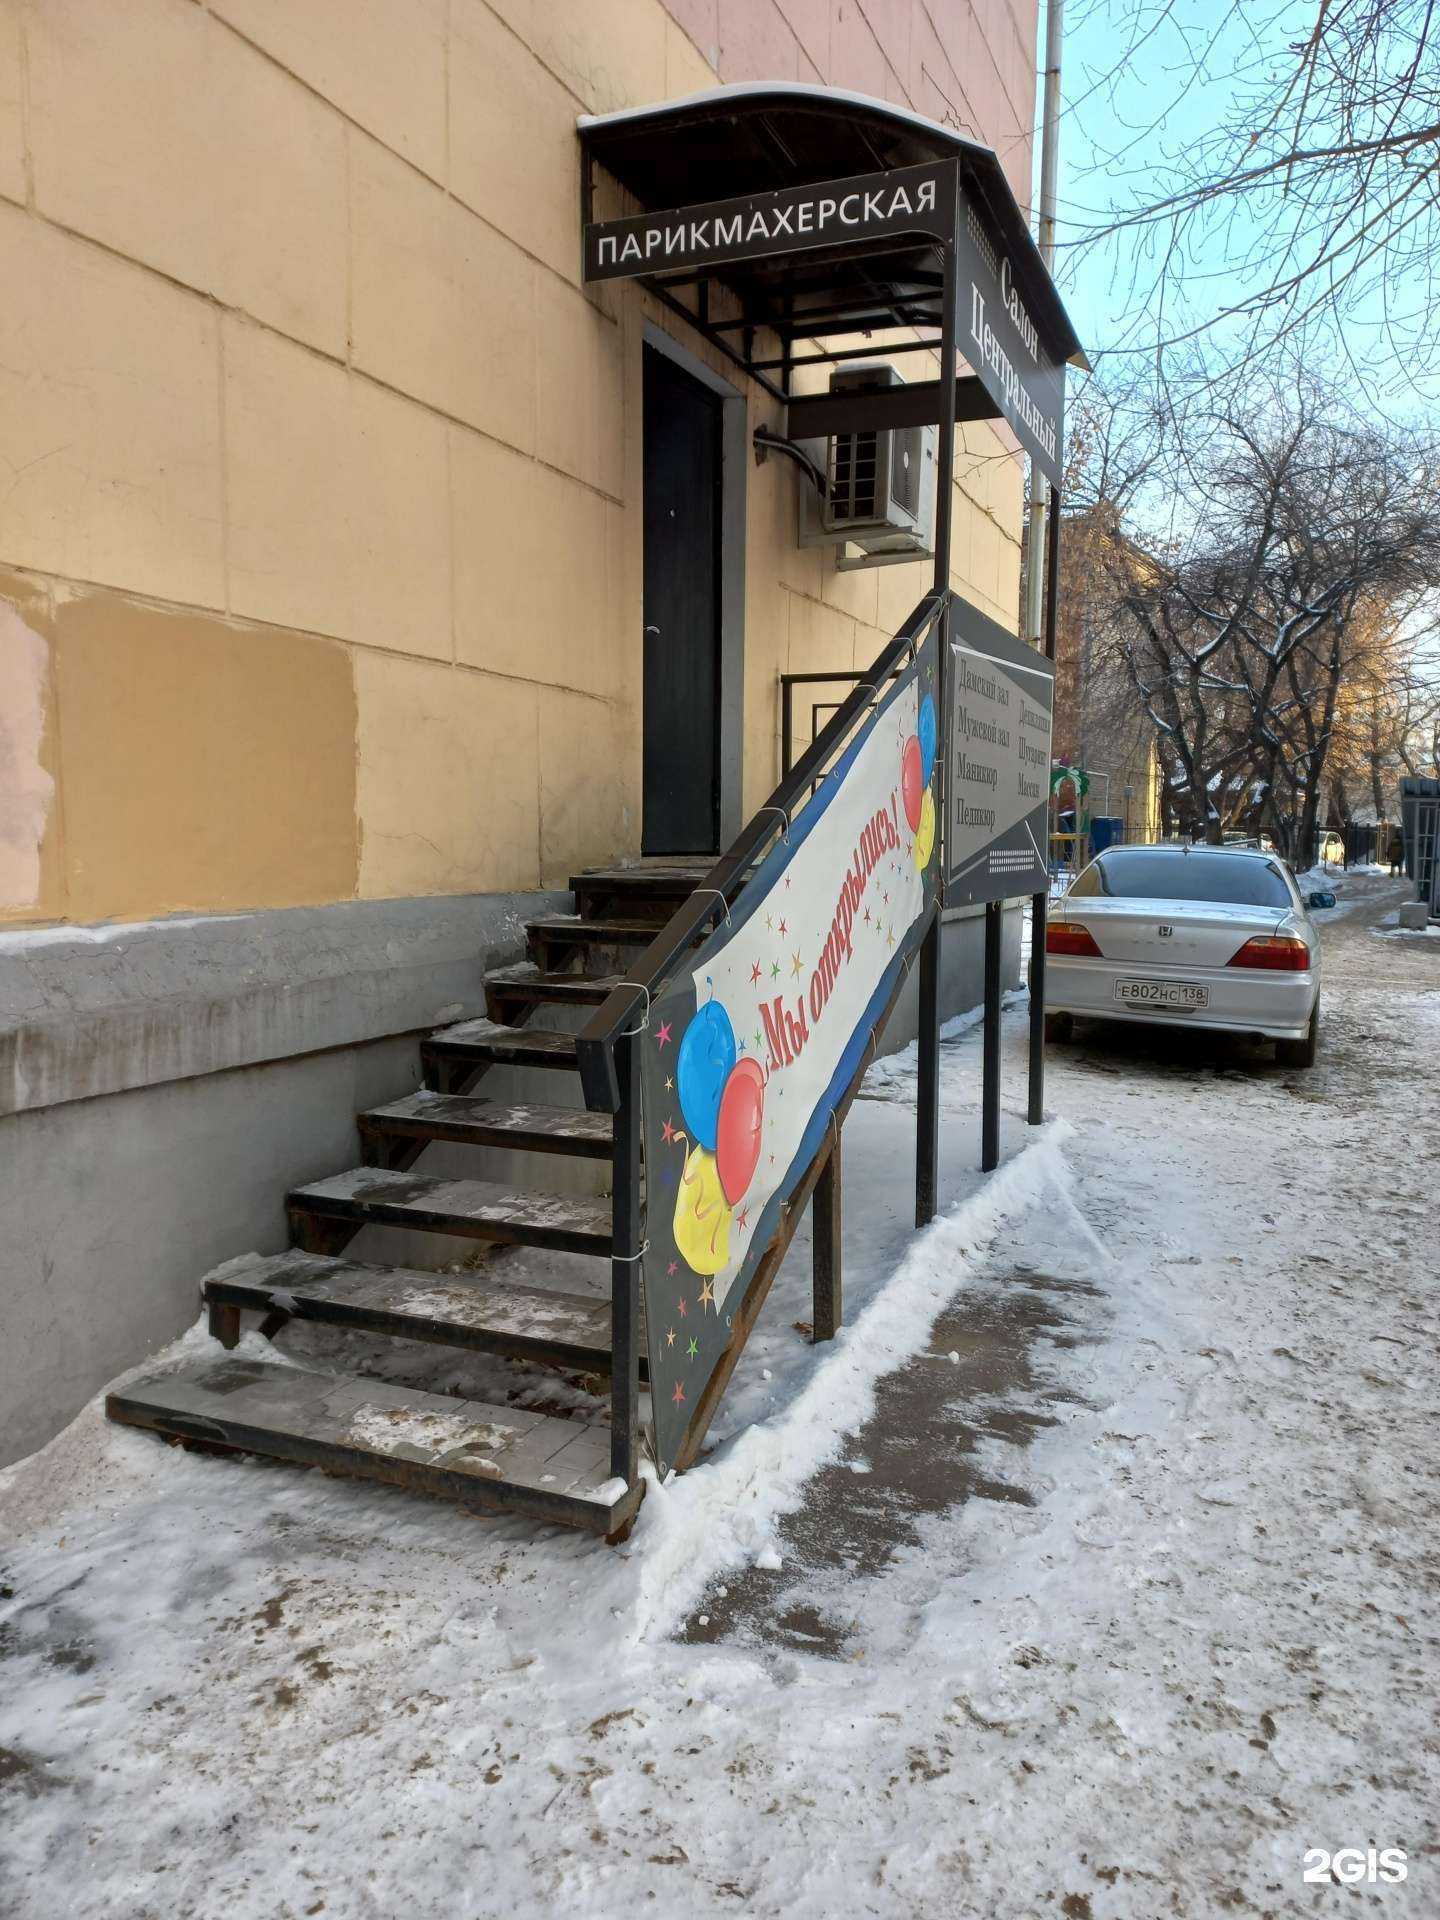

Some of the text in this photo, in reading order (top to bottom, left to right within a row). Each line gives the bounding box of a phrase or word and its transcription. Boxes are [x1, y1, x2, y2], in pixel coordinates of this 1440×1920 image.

[597, 178, 937, 267] ПАРИКМАХЕРСКАЯ
[1001, 256, 1039, 362] Салон
[970, 281, 1057, 462] Центральный
[958, 658, 997, 701] Дамский
[957, 705, 997, 744] Мужской
[997, 728, 1010, 748] зал
[956, 751, 998, 791] Маникюр
[956, 798, 996, 832] Педикюр
[758, 790, 901, 1071] Мы открылись!
